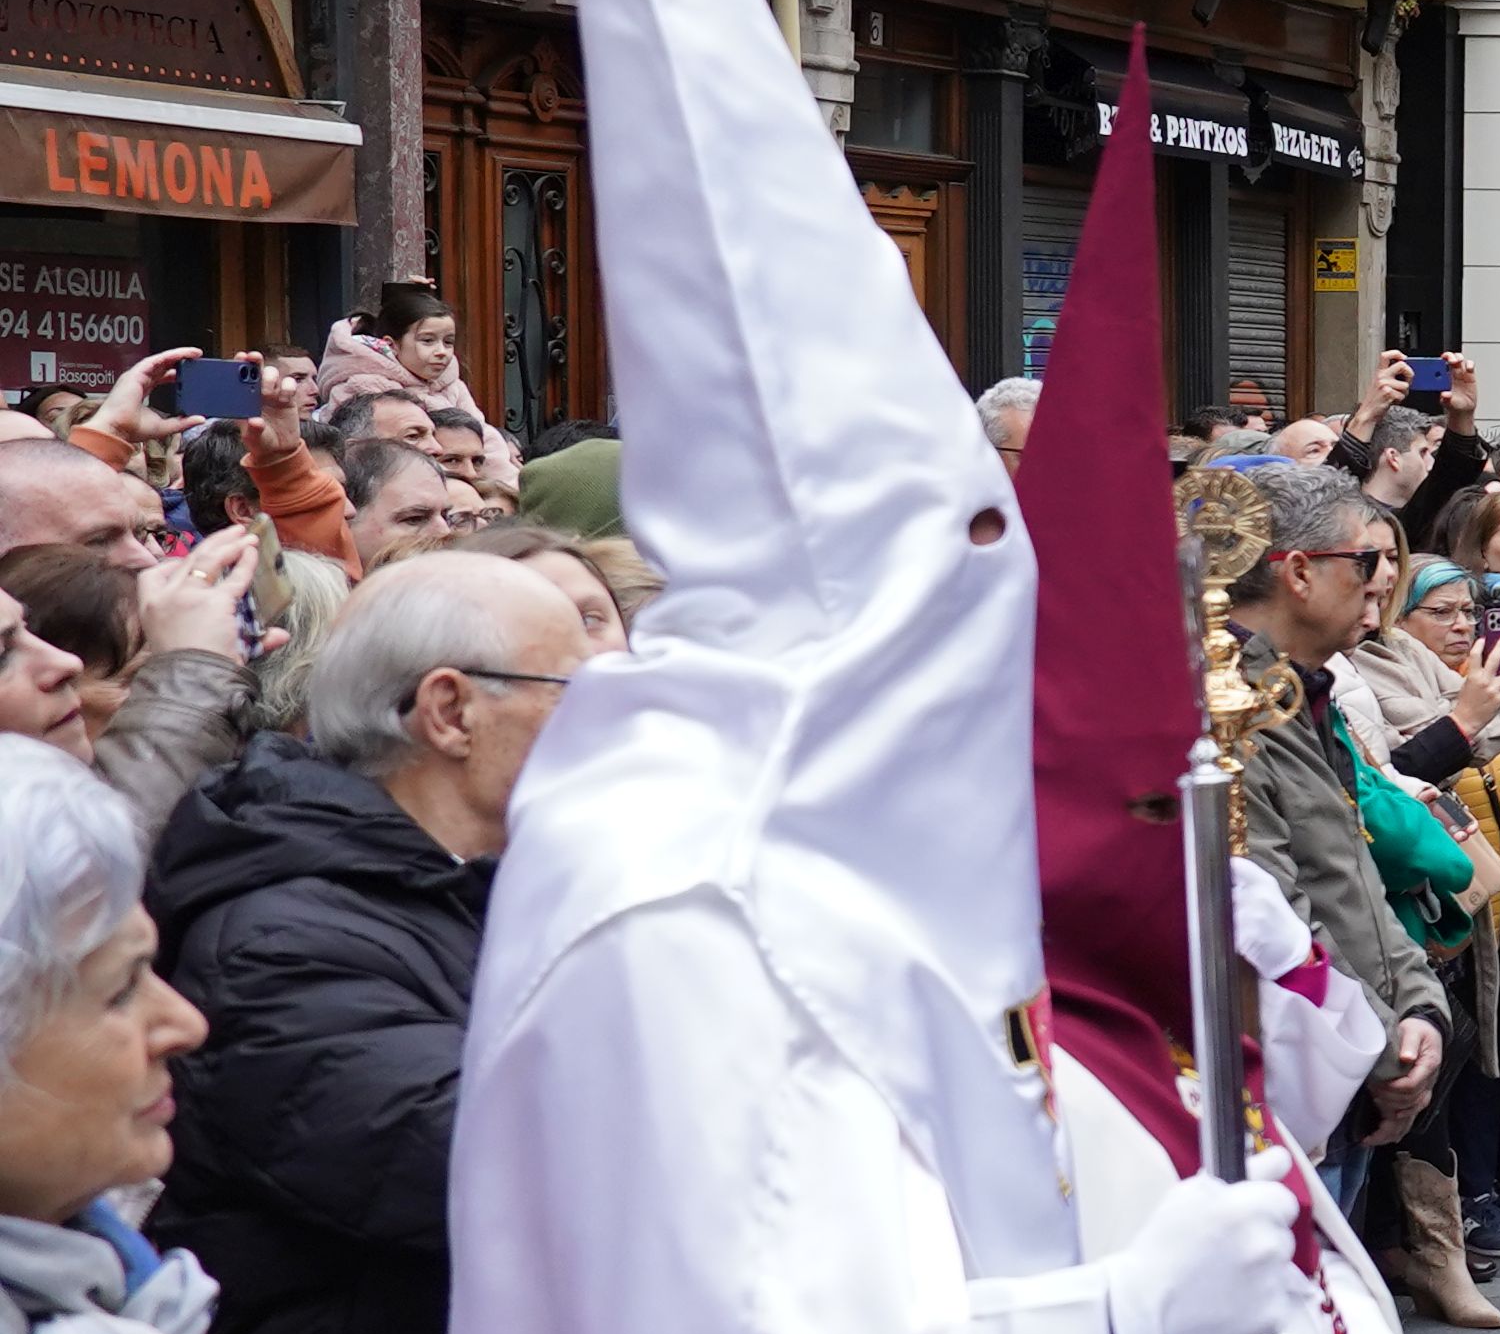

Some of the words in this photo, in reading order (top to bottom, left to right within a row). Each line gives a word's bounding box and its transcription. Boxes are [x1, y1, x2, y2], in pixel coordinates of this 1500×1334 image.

[872, 16, 880, 42] 6
[1150, 113, 1162, 143] &
[46, 128, 273, 209] LEMONA
[34, 265, 146, 300] ALQUILA
[37, 311, 144, 345] 4156600
[59, 367, 114, 387] Basagoiti
